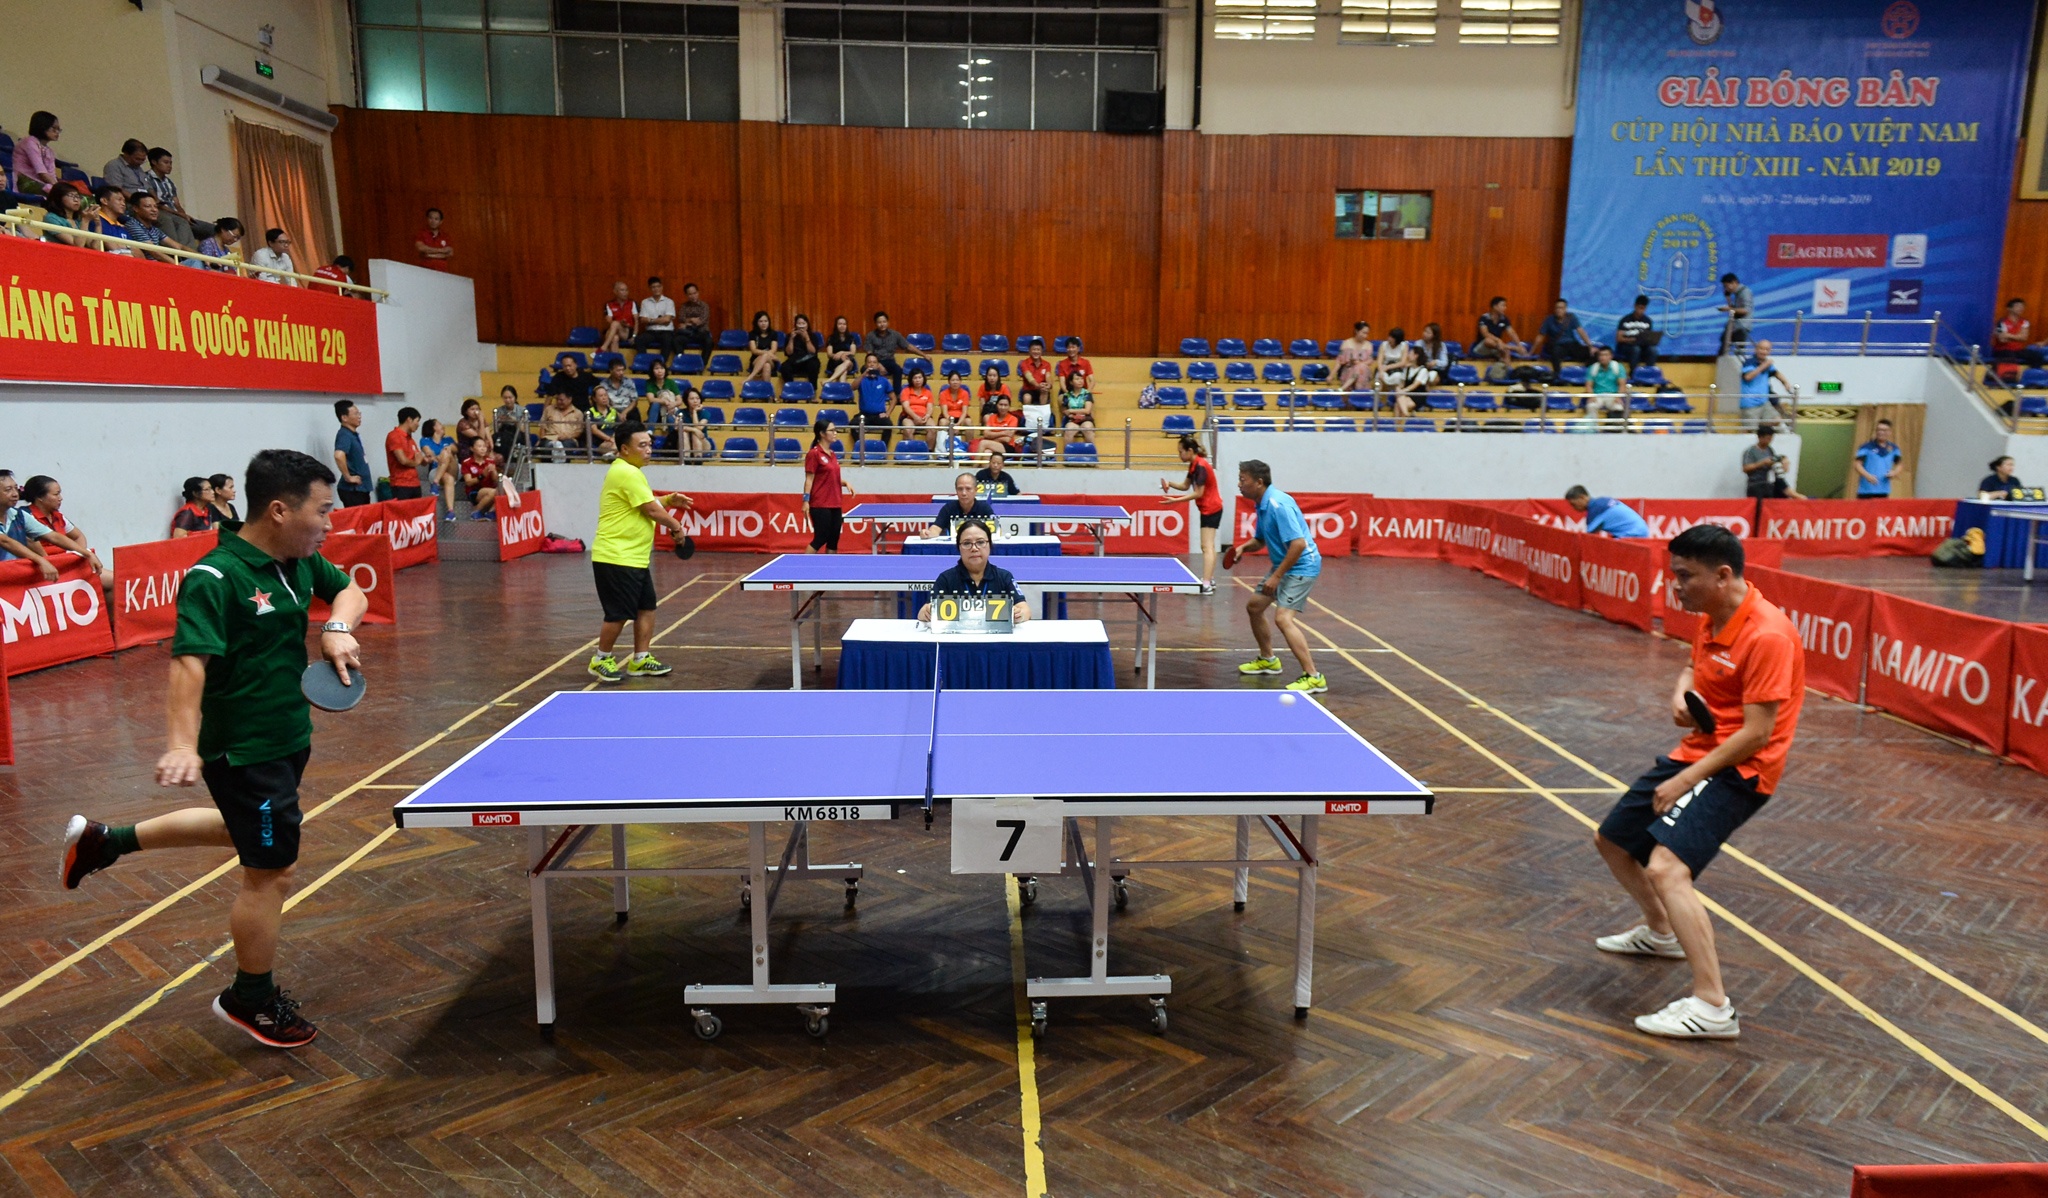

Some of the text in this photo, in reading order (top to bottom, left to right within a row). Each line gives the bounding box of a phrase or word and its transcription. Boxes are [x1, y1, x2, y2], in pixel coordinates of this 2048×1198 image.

[1659, 67, 1741, 107] GIẢI
[1745, 69, 1851, 107] BÓNG
[1611, 116, 1981, 148] CÚP HỘI NHÀ BÁO VIỆT NAM
[1634, 146, 1686, 176] LẦN
[1692, 151, 1750, 177] THỨ
[1752, 156, 1801, 176] XIII
[1821, 152, 1882, 176] NĂM
[1885, 156, 1942, 176] 2019
[1794, 246, 1877, 258] AGRIBANK
[81, 288, 147, 349] TÁM
[150, 297, 187, 352] VÀ
[190, 300, 250, 359] QUỐC
[253, 314, 318, 363] KHÁNH
[320, 328, 347, 366] 2/9
[996, 484, 1005, 493] 2
[387, 512, 435, 550] KAMITO
[501, 510, 543, 546] KAMITO
[1010, 523, 1019, 537] 9
[1444, 522, 1491, 550] KAMITO
[1766, 518, 1867, 540] KAMITO
[1526, 547, 1572, 583] KAMITO
[1580, 561, 1640, 602] KAMITO
[939, 600, 958, 621] 0
[988, 600, 1006, 621] 7
[1872, 632, 1990, 706] KAMITO
[478, 814, 512, 823] KAMITO
[784, 806, 860, 820] KM6818
[1331, 803, 1361, 811] KAMITO
[259, 799, 273, 847] VICTOR
[995, 820, 1026, 861] 7
